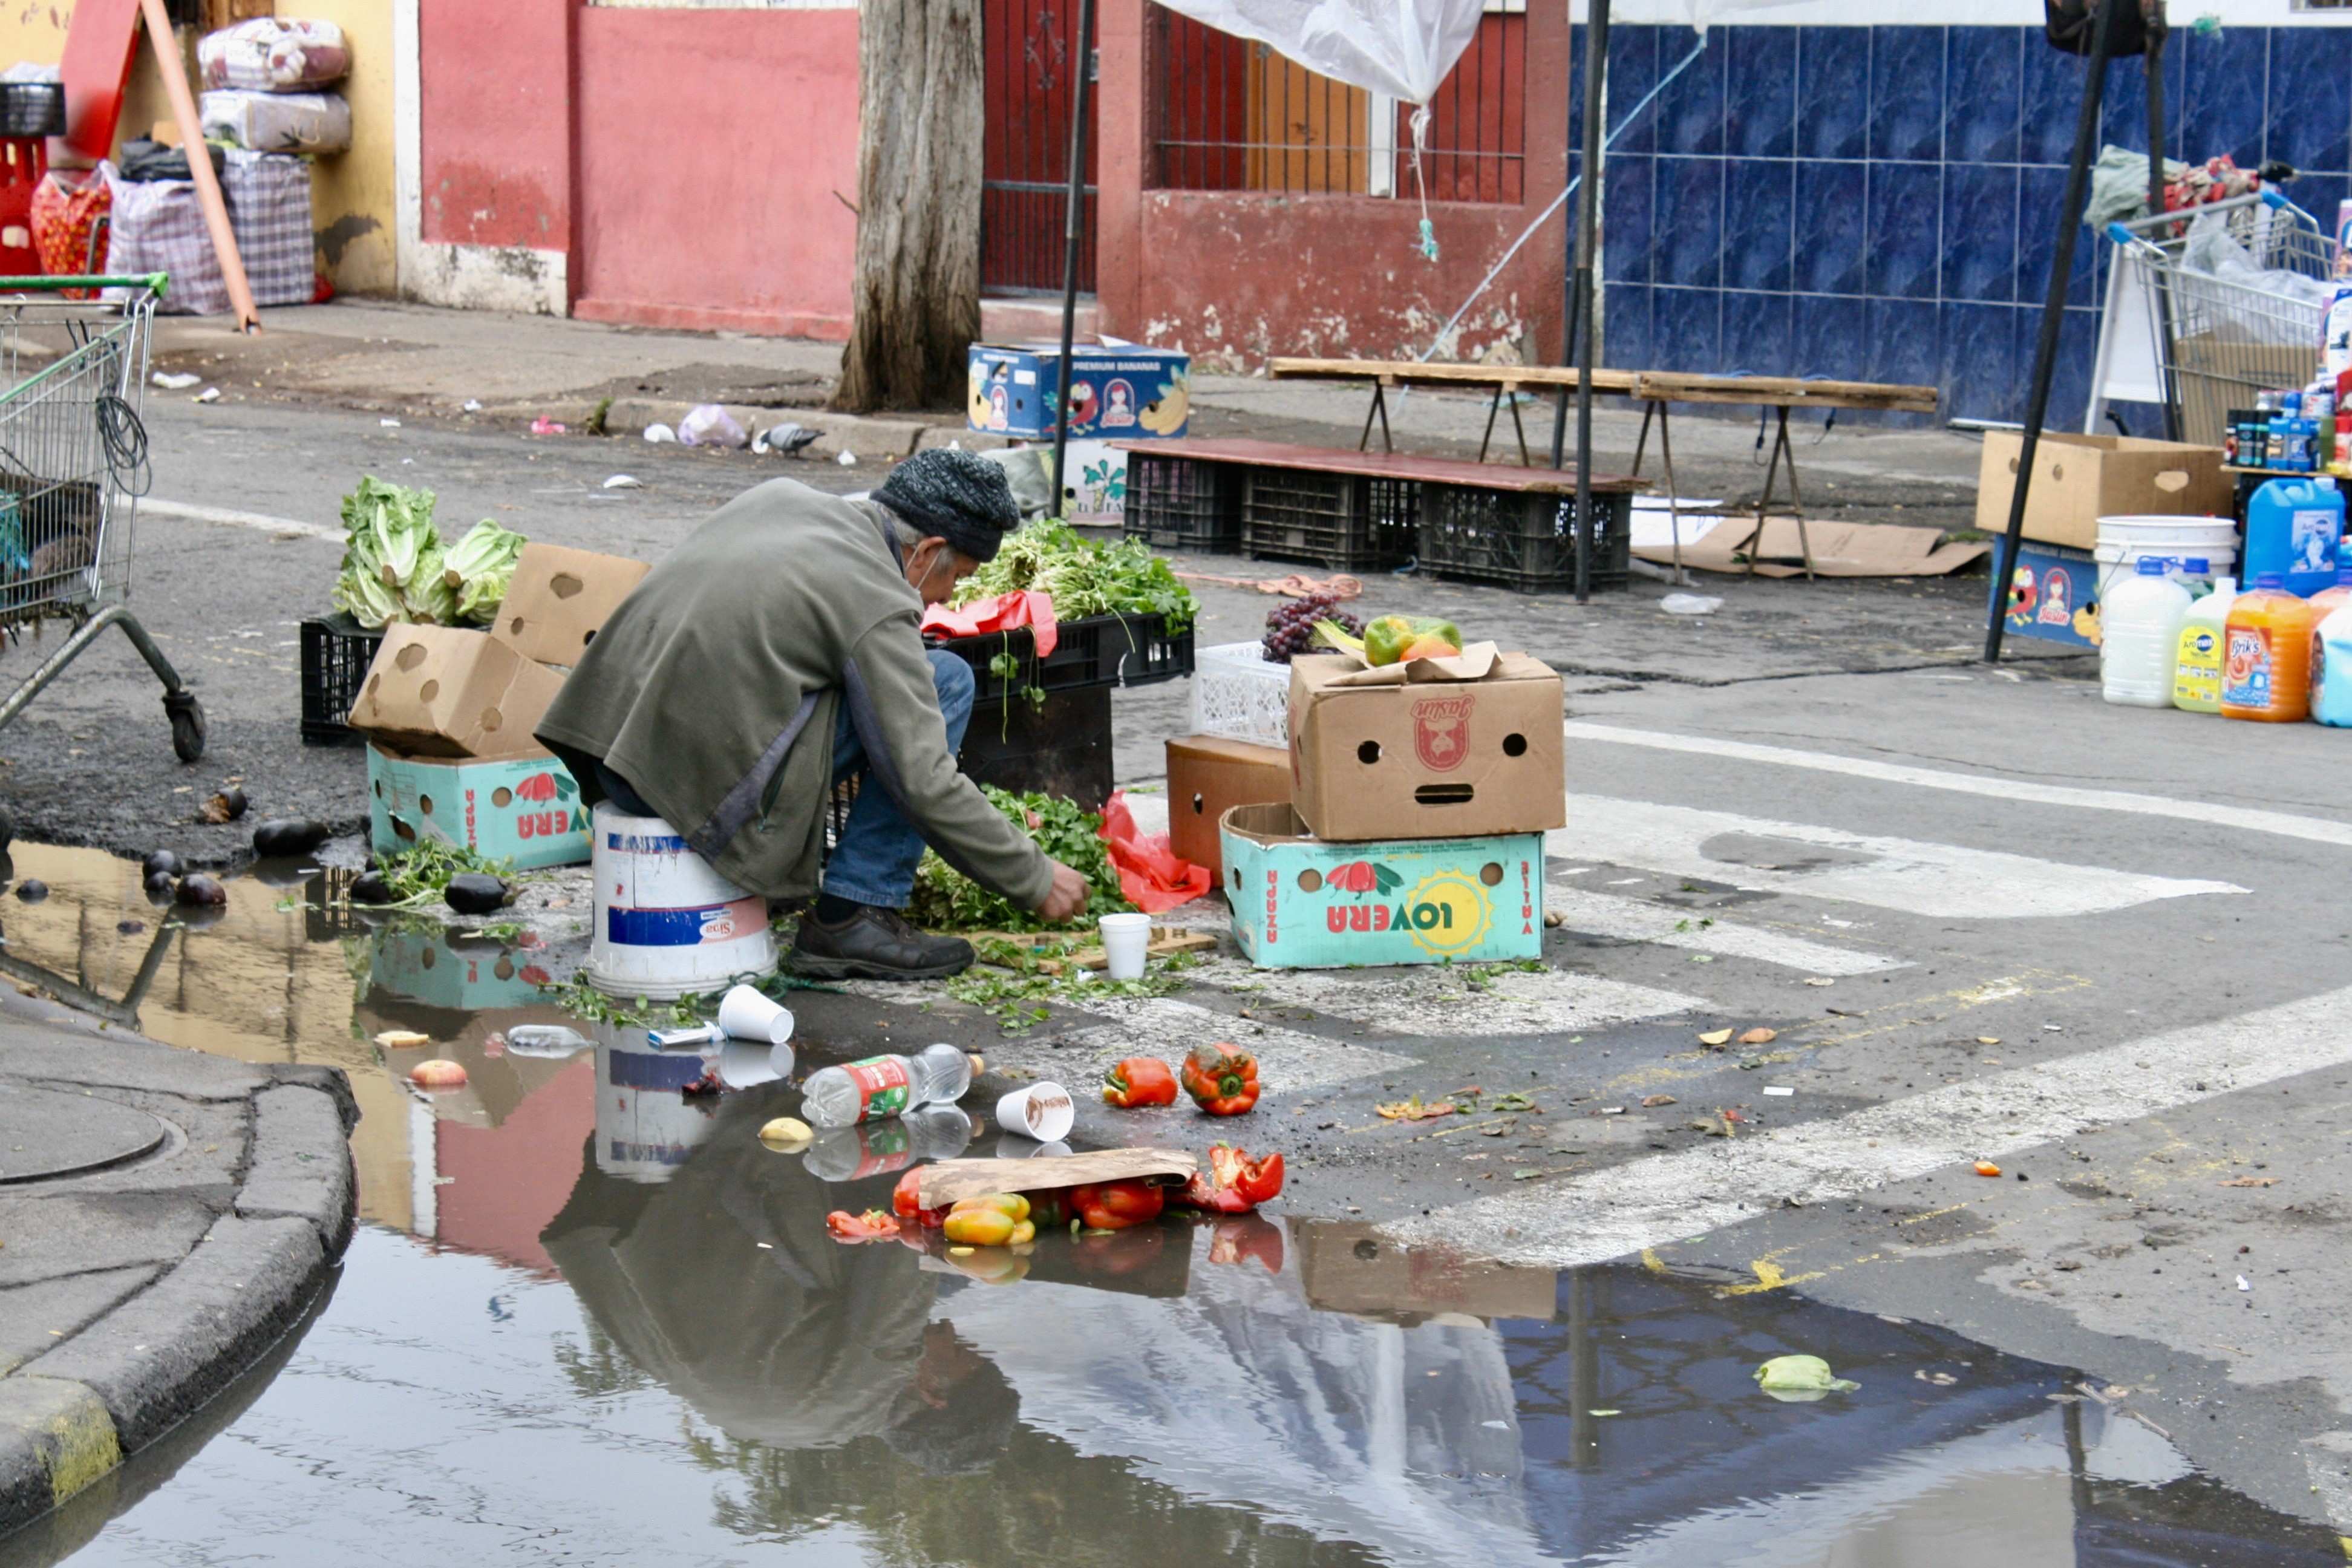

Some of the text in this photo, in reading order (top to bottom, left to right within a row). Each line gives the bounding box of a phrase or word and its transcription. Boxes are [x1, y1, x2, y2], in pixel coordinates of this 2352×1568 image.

[1072, 361, 1161, 371] PREMIUM BANANAS
[517, 809, 592, 840] VERA
[1266, 869, 1278, 944] AZAPA
[1521, 860, 1534, 935] VALLE
[1326, 902, 1453, 934] LOVERA
